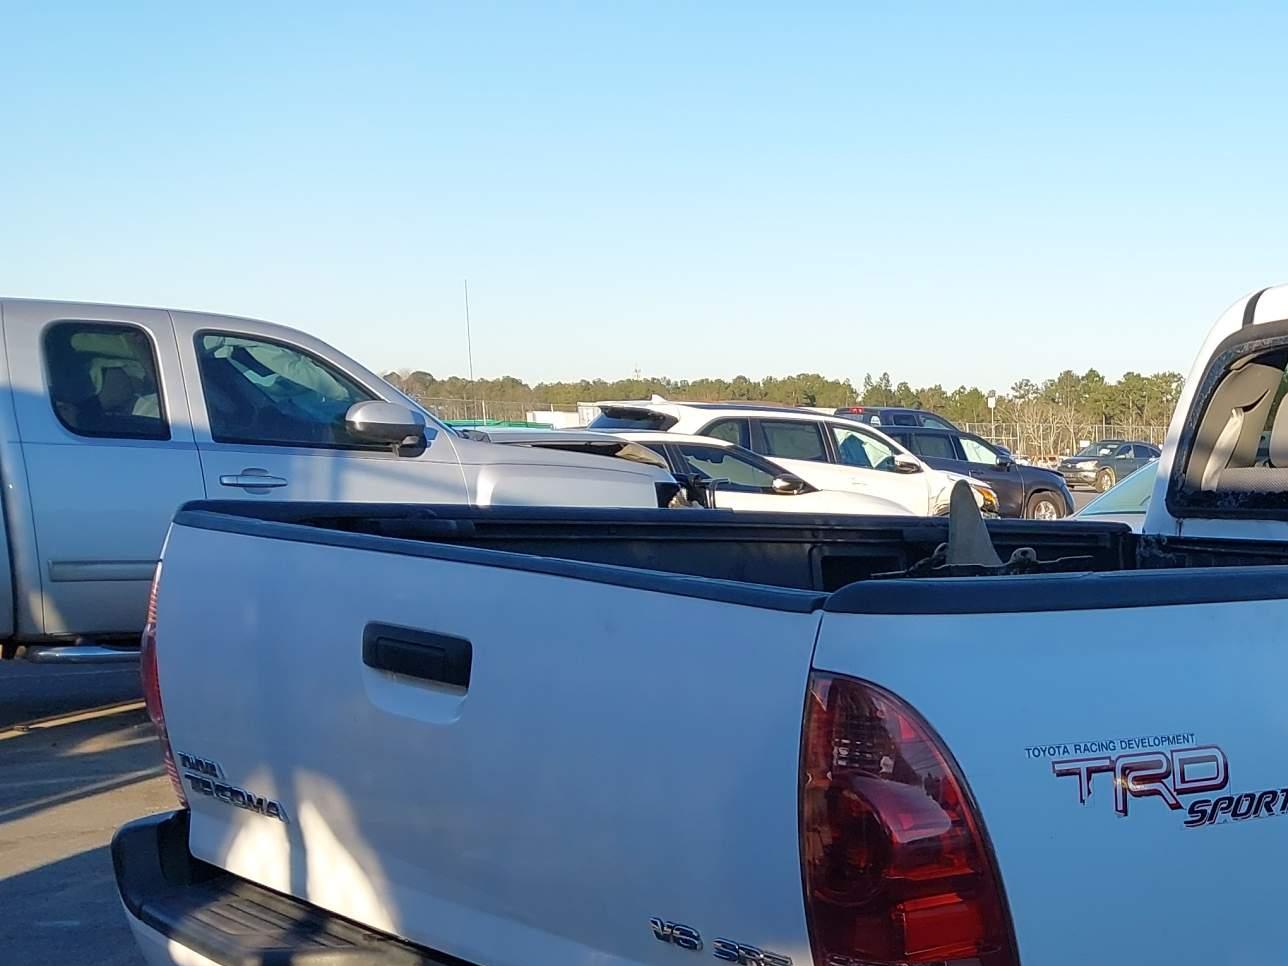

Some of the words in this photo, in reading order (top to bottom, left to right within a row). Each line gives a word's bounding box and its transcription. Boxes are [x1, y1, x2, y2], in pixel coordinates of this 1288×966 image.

[1025, 744, 1070, 759] TOYOTA
[1074, 739, 1117, 754] RACING
[1120, 733, 1195, 750] DEVELOPMENT
[1052, 745, 1229, 816] TRD
[650, 916, 703, 951] V6
